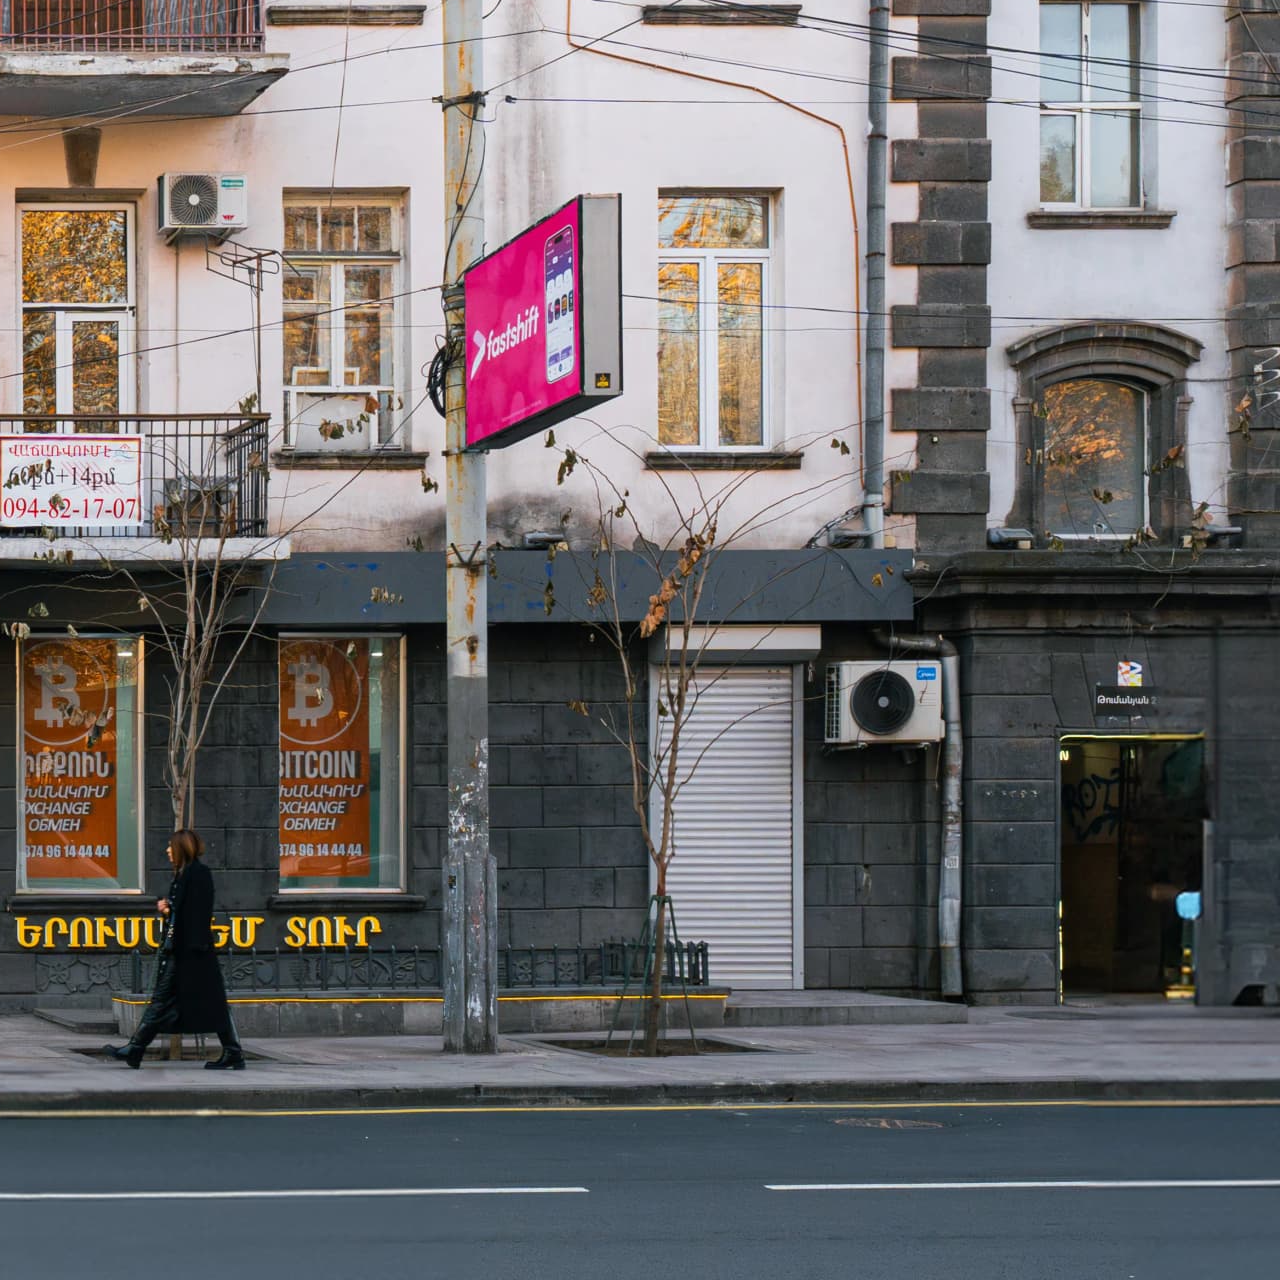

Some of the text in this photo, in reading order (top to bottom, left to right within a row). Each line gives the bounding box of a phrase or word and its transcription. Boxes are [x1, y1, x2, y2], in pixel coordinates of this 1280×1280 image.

[487, 305, 539, 360] fastshift
[4, 497, 136, 519] 094-82-17-07
[28, 818, 81, 832] ОБМЕН
[283, 817, 336, 831] ОБМЕН
[46, 844, 61, 857] 96
[64, 844, 77, 857] 14
[79, 844, 93, 857] 44
[95, 844, 110, 857] 44
[299, 843, 314, 857] 96
[317, 843, 329, 857] 14
[331, 843, 346, 857] 44
[347, 843, 363, 857] 44
[15, 916, 383, 948] ԵՐՈՒՍԱԵՄ ՏՈՒՐ
